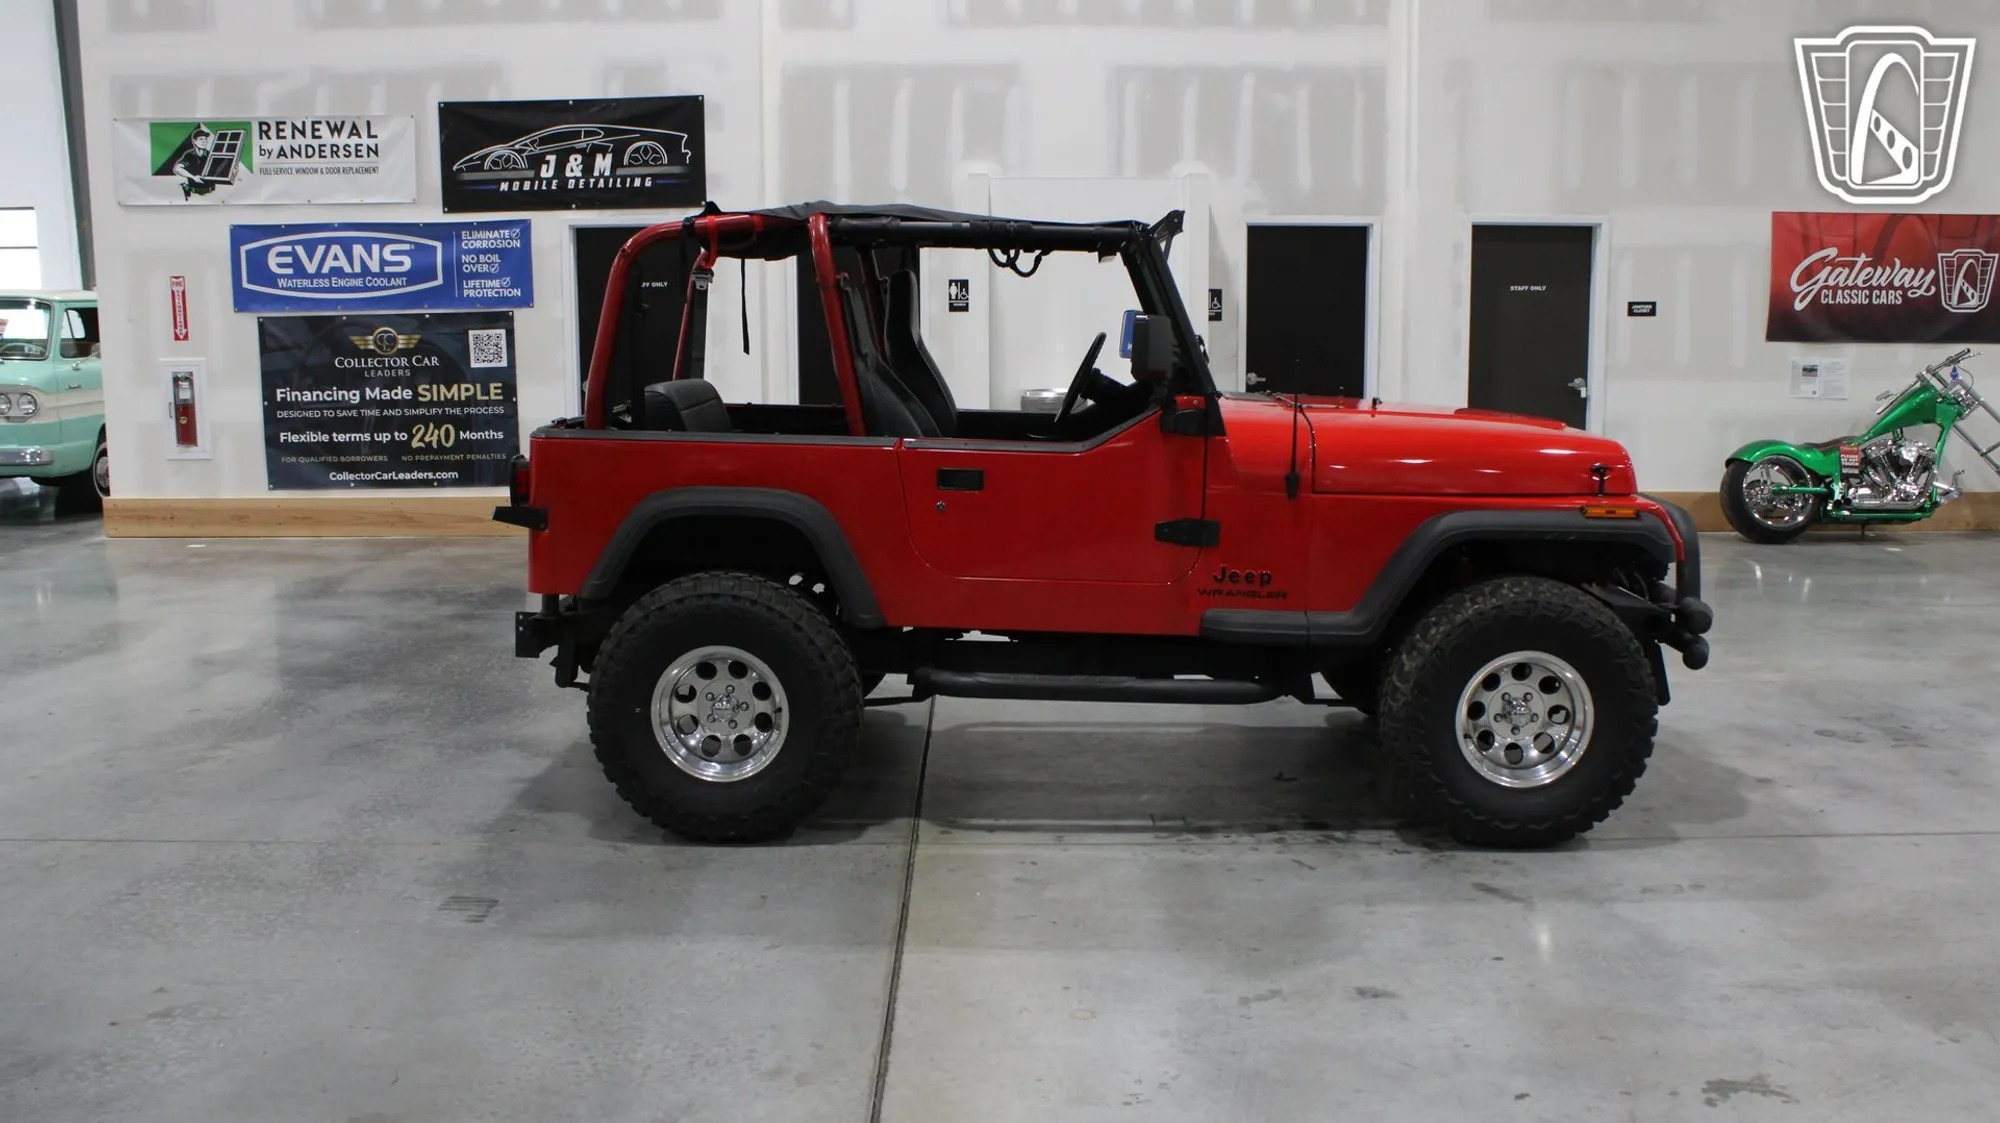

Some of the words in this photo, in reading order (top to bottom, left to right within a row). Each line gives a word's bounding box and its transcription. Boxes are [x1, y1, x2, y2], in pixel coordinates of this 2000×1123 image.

[258, 120, 378, 140] RENEWAL
[259, 145, 273, 160] by
[276, 143, 380, 160] ANDERSEN
[295, 167, 318, 175] WINDOW
[319, 167, 324, 175] &
[325, 167, 341, 175] DOOR
[342, 166, 380, 175] REPLACEMENT
[540, 154, 557, 178] J
[565, 154, 583, 178] &
[593, 153, 612, 177] M
[500, 180, 558, 192] MOBILE
[568, 177, 653, 189] DETAILING
[461, 230, 511, 240] ELIMINATE
[461, 239, 521, 249] CORROSION
[267, 244, 412, 273] EVANS
[462, 255, 478, 264] NO
[479, 254, 501, 263] BOIL
[463, 263, 490, 273] OVER
[277, 277, 330, 289] WATERLESS
[331, 277, 364, 288] ENGINE
[365, 276, 408, 287] COOLANT
[463, 279, 501, 288] LIFETIME
[1789, 247, 1936, 311] Gateway
[463, 287, 521, 297] PROTECTION
[1821, 289, 1870, 305] CLASSIC
[1872, 290, 1903, 305] CARS
[334, 356, 410, 369] COLLECTOR
[412, 355, 440, 367] CAR
[364, 369, 411, 378] LEADERS
[275, 386, 360, 404] Financing
[365, 386, 413, 401] Made
[417, 383, 504, 402] SIMPLE
[277, 410, 321, 418] DESIGNED
[323, 409, 335, 417] TO
[336, 409, 358, 417] SAVE
[360, 409, 380, 417] TIME
[382, 408, 402, 416] AND
[403, 407, 443, 416] SIMPLIFY
[444, 407, 462, 415] THE
[463, 406, 505, 415] PROCESS
[279, 431, 330, 443] Flexible
[332, 431, 371, 442] terms
[374, 431, 391, 444] up
[393, 431, 408, 442] to
[410, 422, 456, 449] 240
[459, 430, 504, 441] Months
[298, 455, 338, 463] QUALIFIED
[340, 455, 388, 463] BORROWERS
[402, 454, 413, 462] NO
[415, 454, 465, 462] PREPAYMENT
[466, 452, 507, 461] PENALTIES
[329, 470, 459, 481] CollectorCarLeaders.com
[1213, 565, 1273, 588] Jeep
[1197, 588, 1288, 599] WRANGLER
